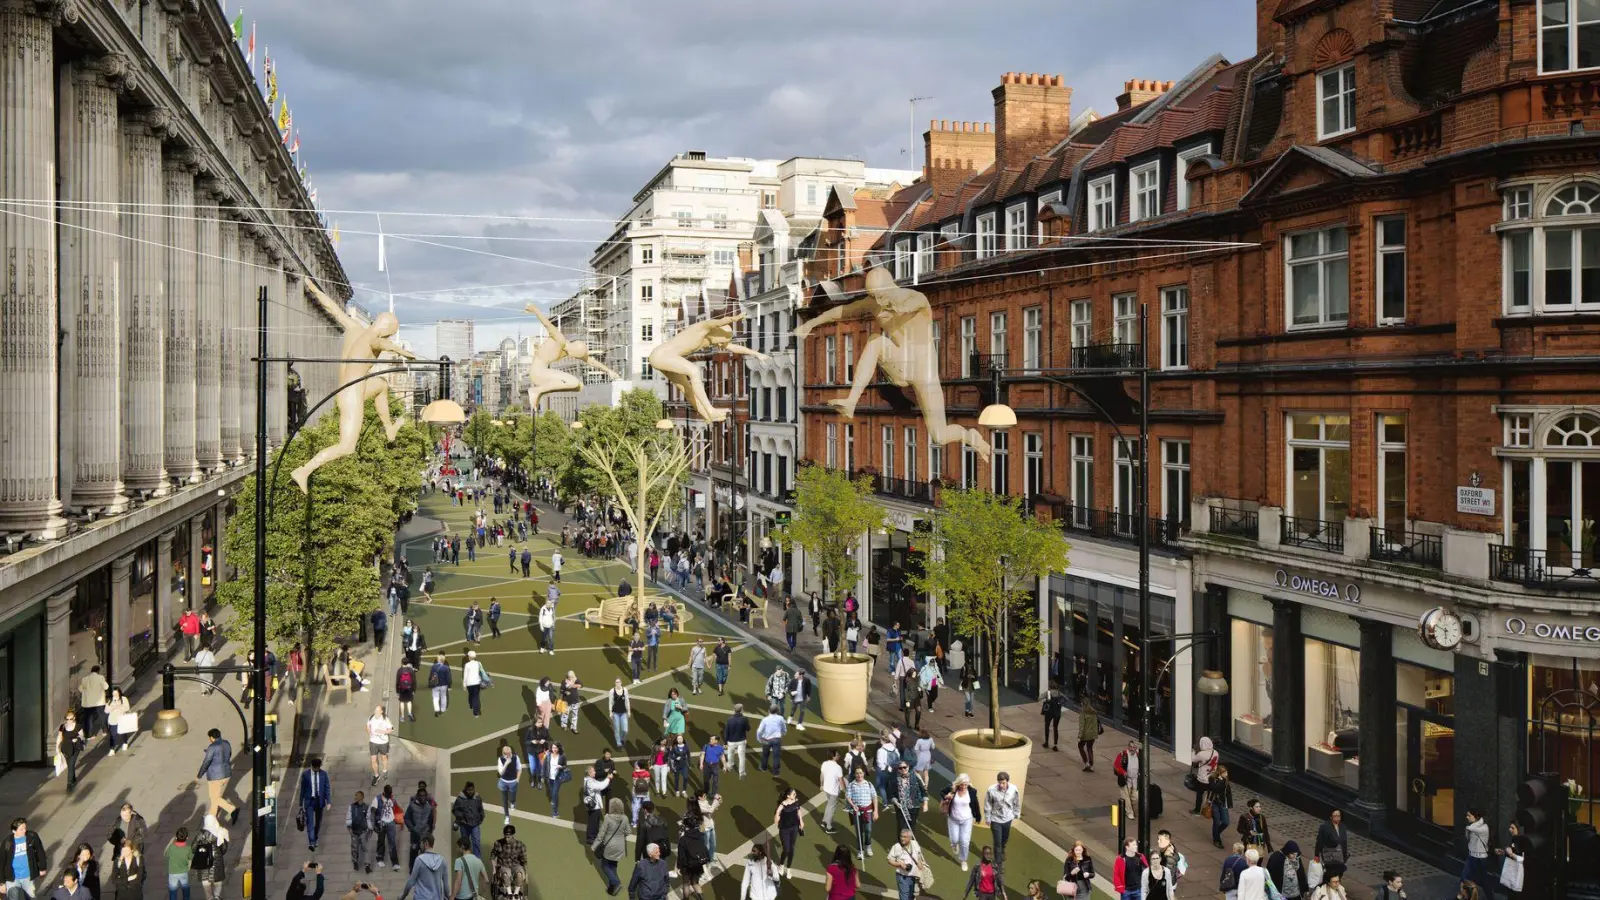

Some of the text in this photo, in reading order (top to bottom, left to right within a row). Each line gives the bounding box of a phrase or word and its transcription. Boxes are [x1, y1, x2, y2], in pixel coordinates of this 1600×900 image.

[1460, 490, 1483, 498] OXFORD
[1460, 497, 1480, 506] STREET
[1291, 575, 1339, 598] OMEGA
